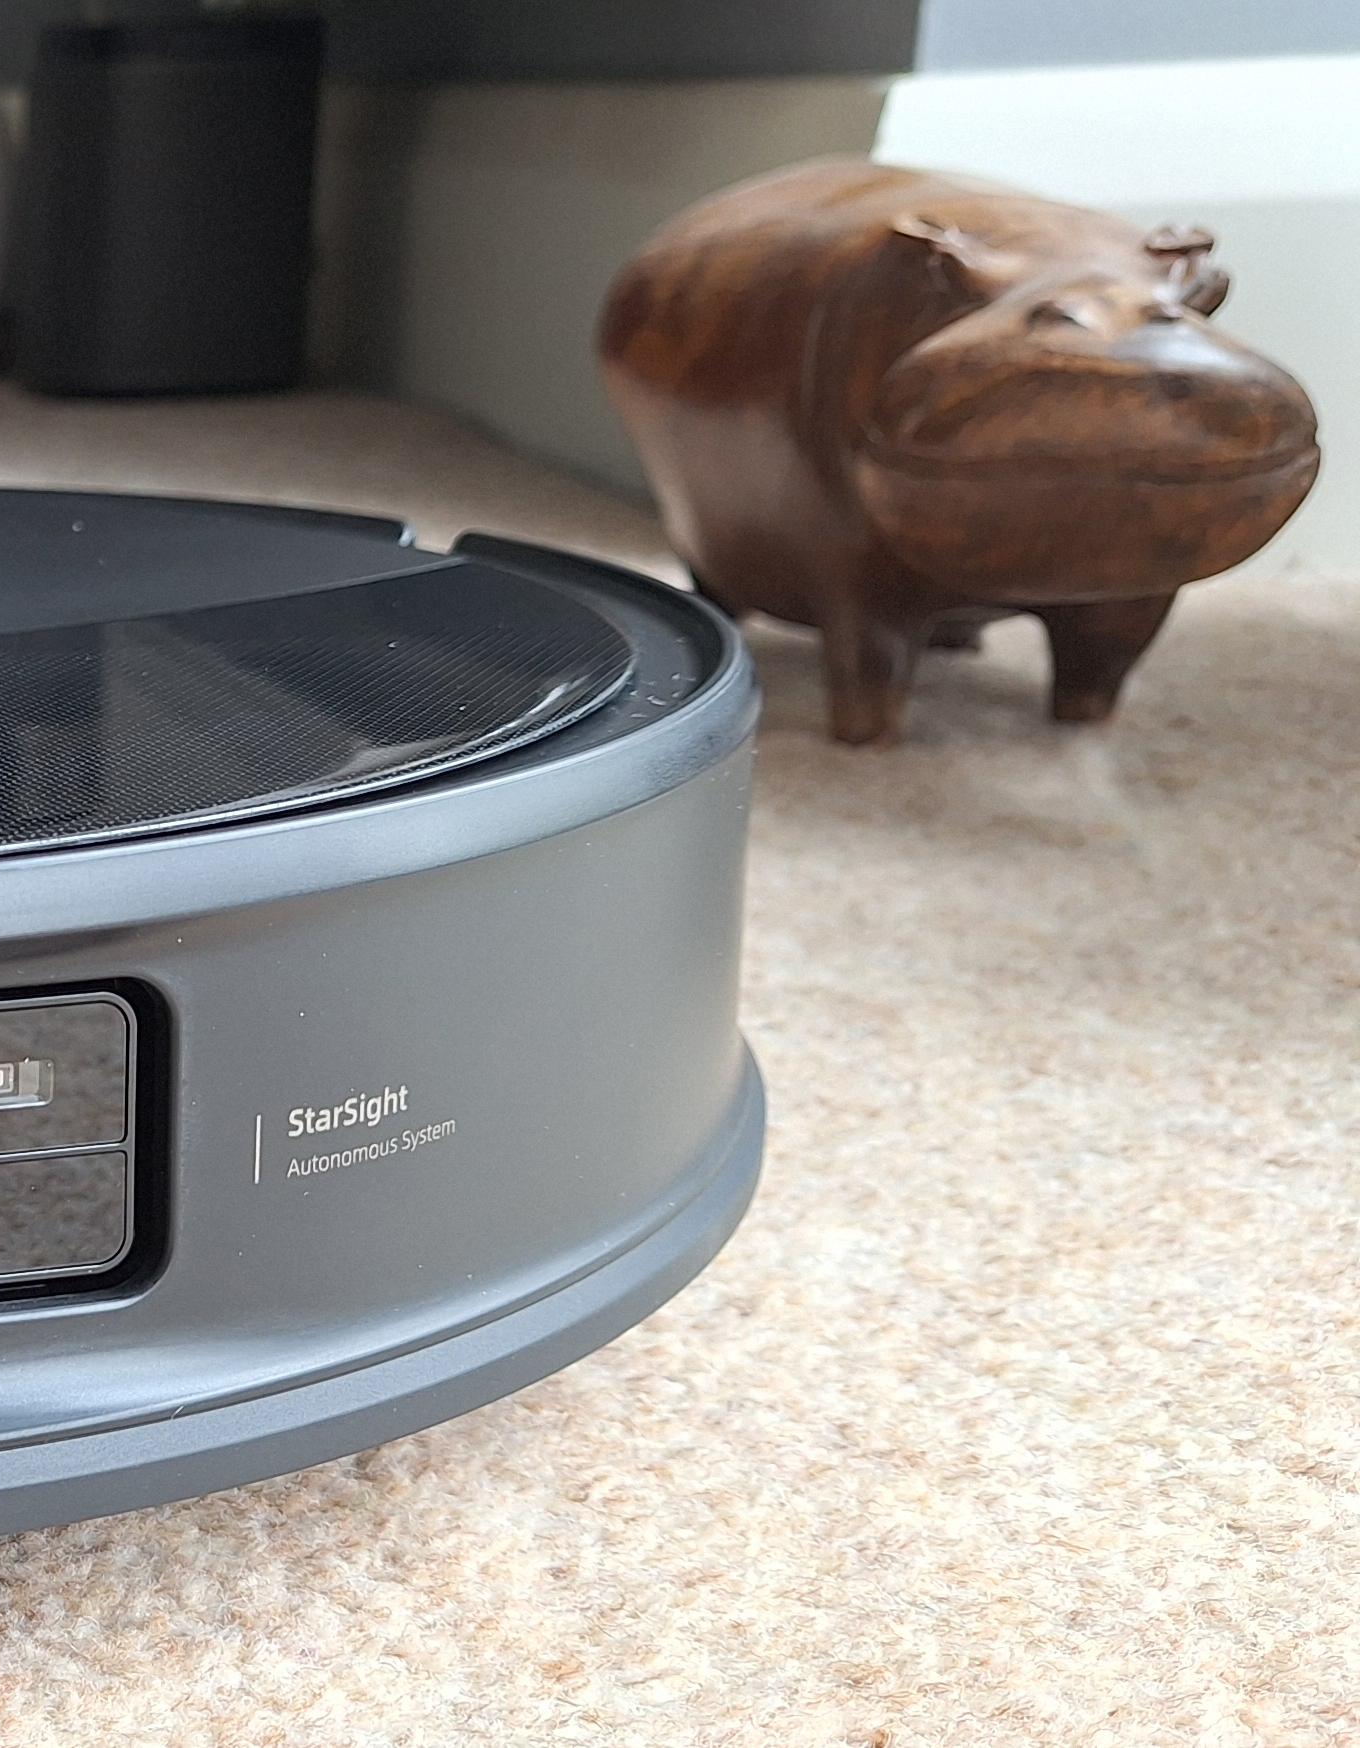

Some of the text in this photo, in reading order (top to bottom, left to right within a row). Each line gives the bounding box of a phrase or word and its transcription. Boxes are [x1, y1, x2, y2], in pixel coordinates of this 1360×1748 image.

[287, 1085, 409, 1137] StarSight
[286, 1119, 456, 1178] Autonomous System
